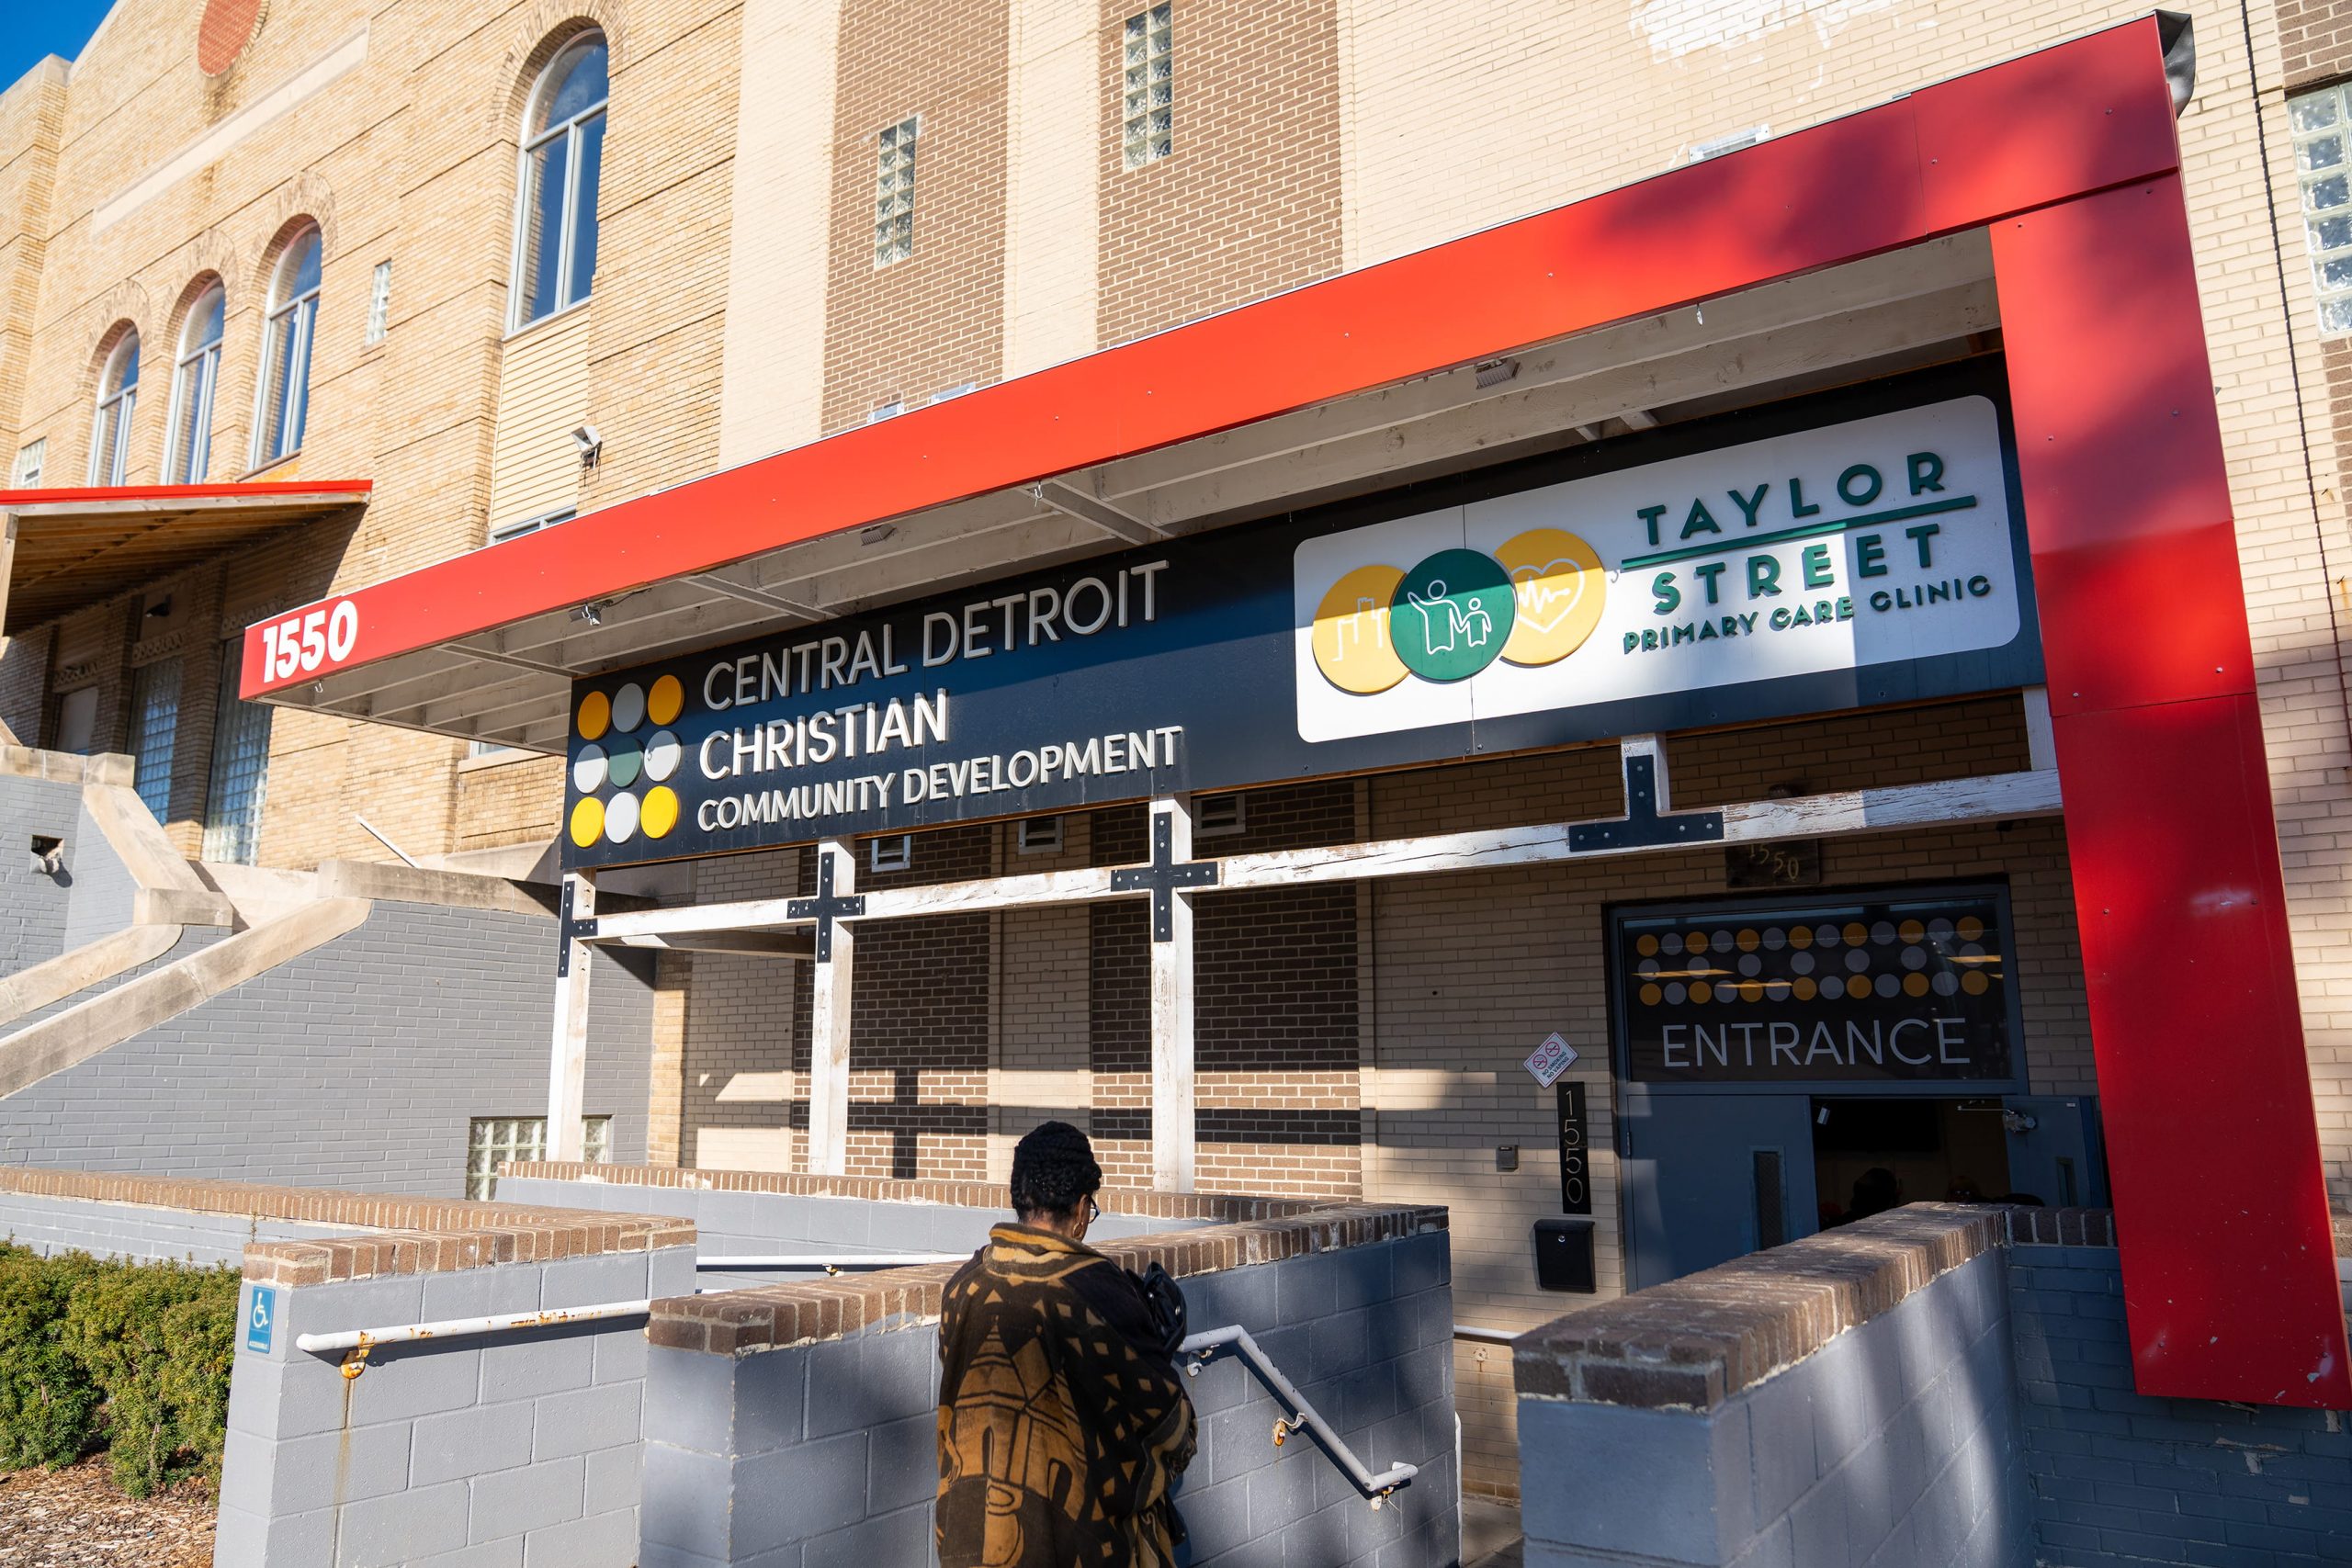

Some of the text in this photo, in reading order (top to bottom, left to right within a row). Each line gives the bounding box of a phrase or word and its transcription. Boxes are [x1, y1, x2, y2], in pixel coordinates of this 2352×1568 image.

[1637, 451, 1945, 546] TAYLOR
[1623, 574, 1991, 654] PRIMARY CARE CLINIC
[1653, 523, 1940, 615] STREET
[263, 600, 358, 683] 1550
[703, 559, 1170, 711] CENTRAL DETROIT
[696, 725, 1183, 832] COMMUNITY DEVELOPMENT
[699, 687, 947, 781] CHRISTIAN
[1548, 1051, 1567, 1070] SMOKING
[1553, 1056, 1569, 1073] VAPING
[1662, 1017, 1971, 1068] ENTRANCE
[1564, 1089, 1583, 1204] 1550
